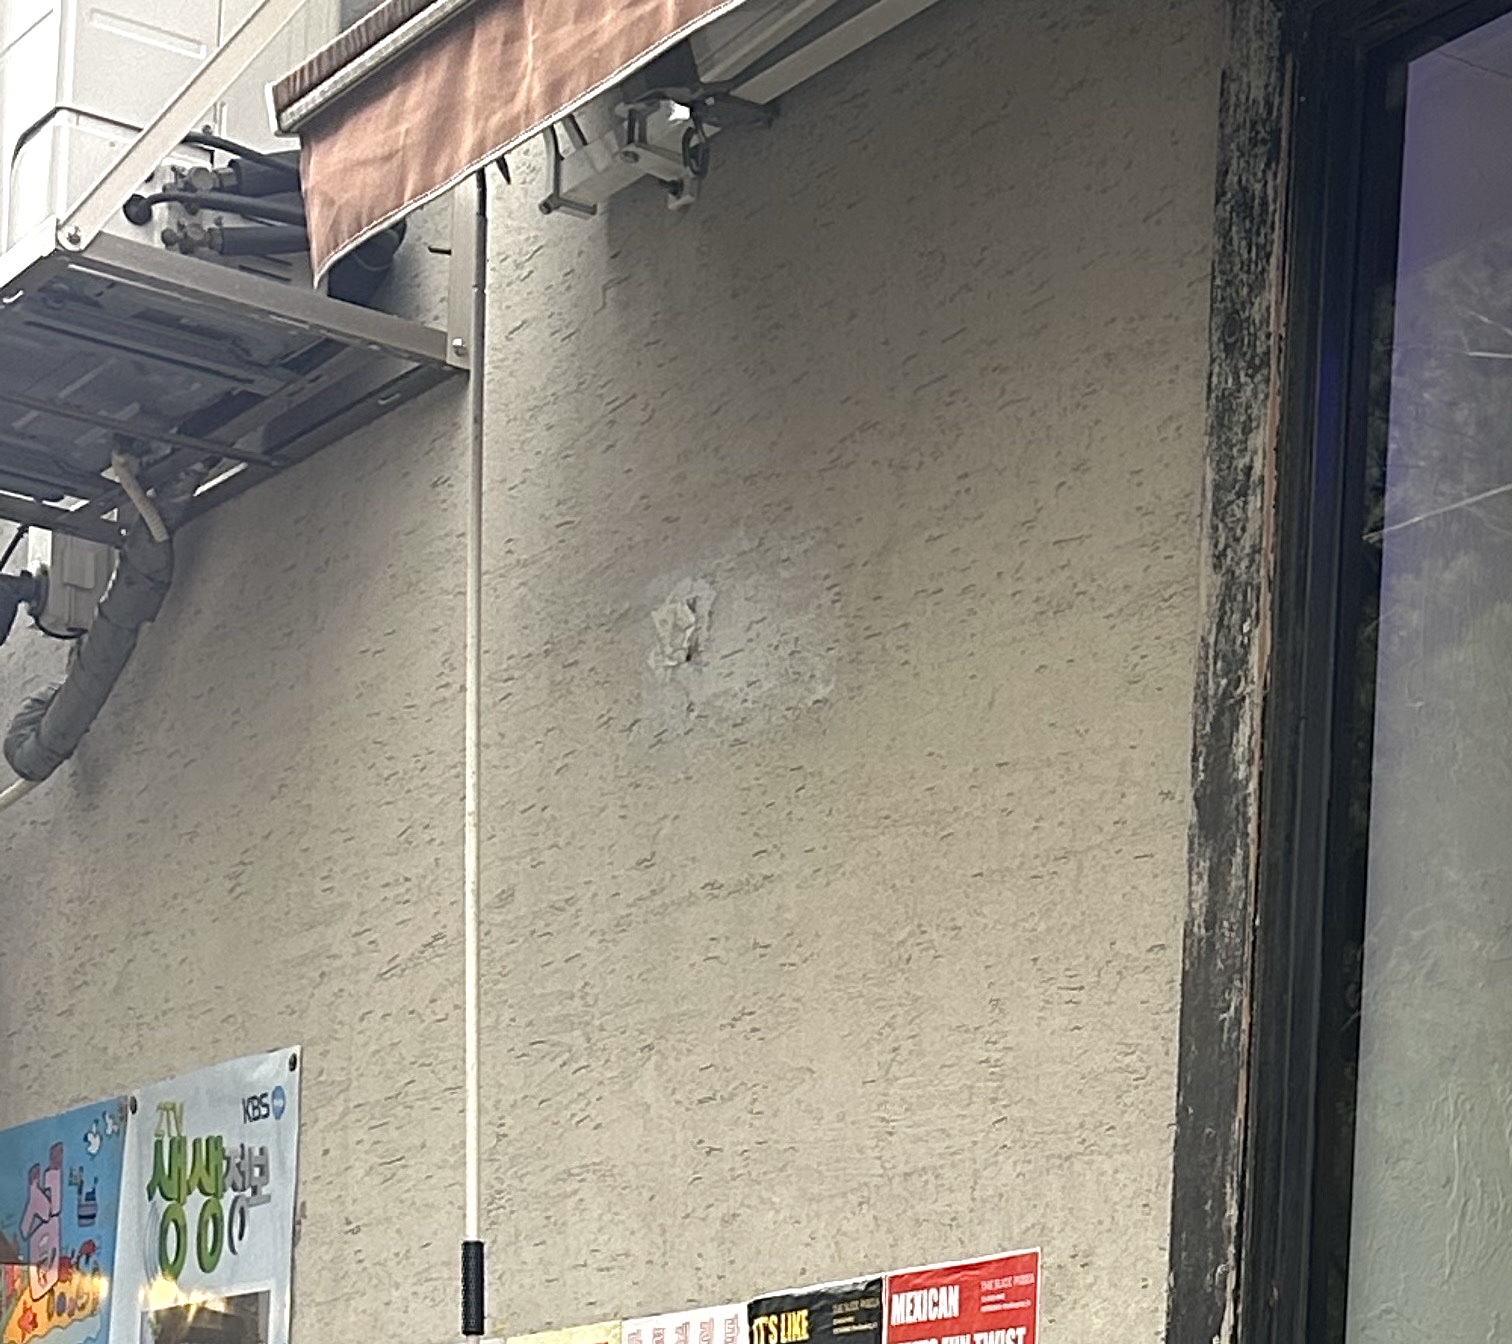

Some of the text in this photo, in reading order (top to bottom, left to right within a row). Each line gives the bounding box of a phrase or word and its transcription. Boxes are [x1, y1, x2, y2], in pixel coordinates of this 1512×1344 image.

[242, 1092, 270, 1124] KBS
[891, 1285, 959, 1326] MEXICAN
[780, 1309, 810, 1343] LIKE
